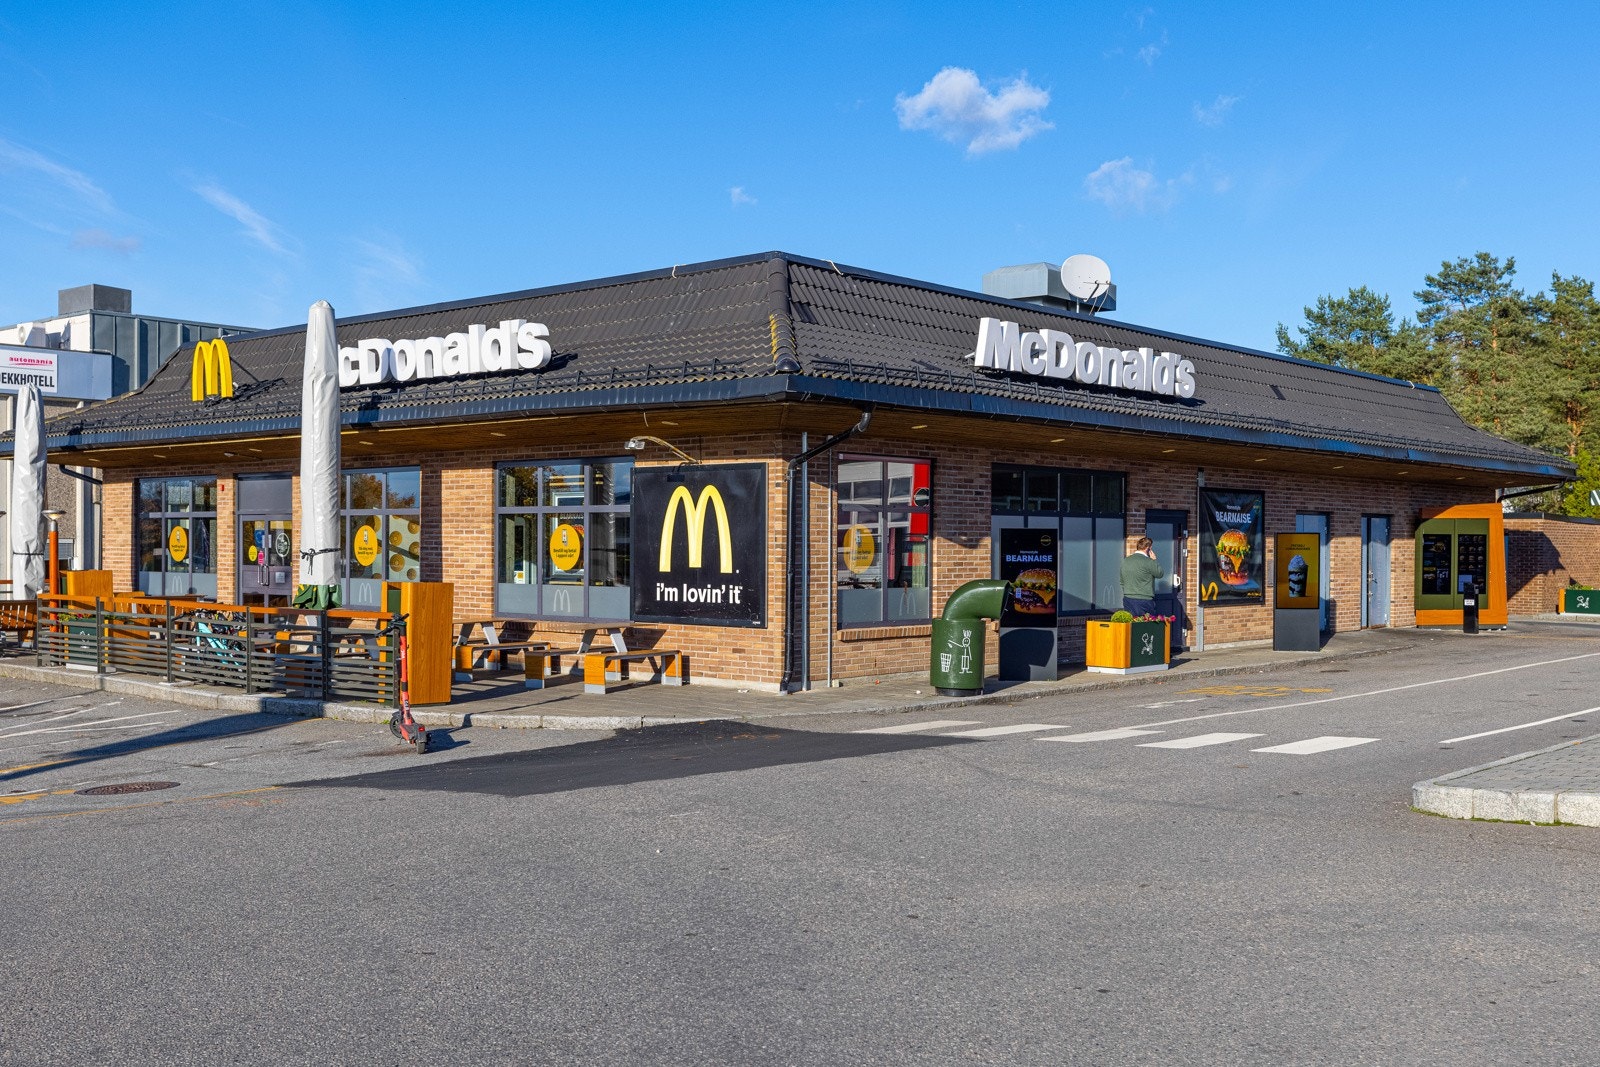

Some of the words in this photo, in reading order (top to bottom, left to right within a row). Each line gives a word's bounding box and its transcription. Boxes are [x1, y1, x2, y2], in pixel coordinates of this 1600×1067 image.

[9, 356, 53, 365] automania
[337, 318, 551, 388] cDonald's
[974, 316, 1196, 399] McDonald's
[0, 372, 55, 388] EKKHOTELL
[1215, 511, 1252, 524] BEARNAISE
[1005, 554, 1053, 562] BEARNAISE
[656, 582, 679, 602] i'm
[682, 583, 726, 604] lovin'
